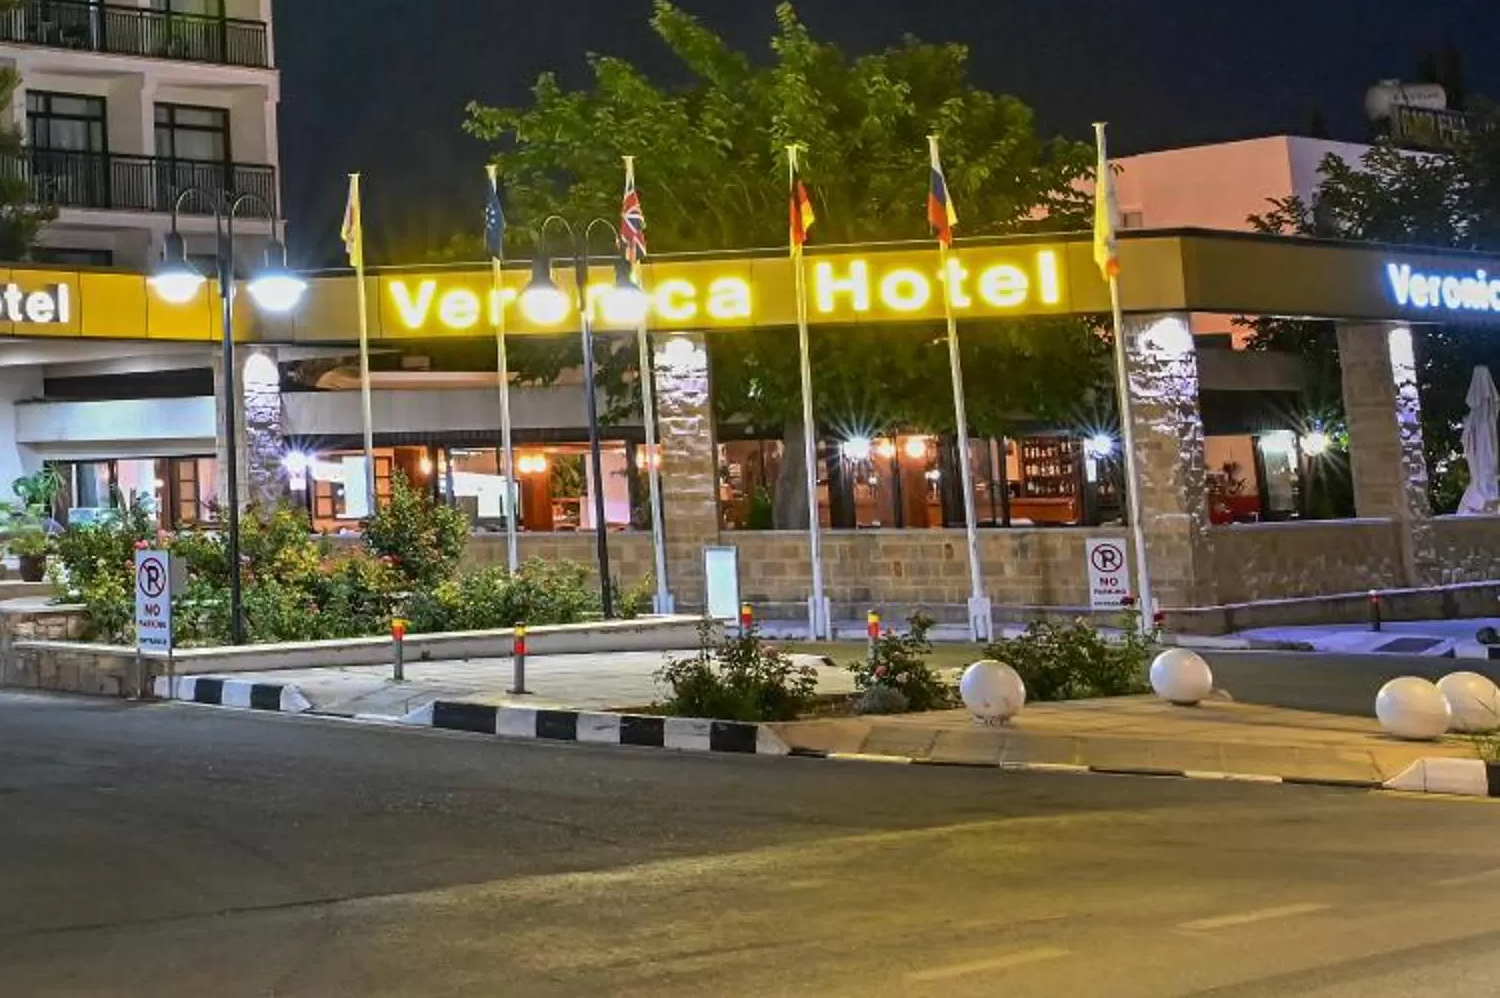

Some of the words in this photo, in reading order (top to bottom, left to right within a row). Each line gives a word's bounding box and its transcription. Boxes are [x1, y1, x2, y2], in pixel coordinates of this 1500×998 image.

[388, 275, 752, 329] Vernca
[815, 249, 1061, 313] Hotel
[1099, 577, 1119, 587] NO
[143, 603, 161, 617] NO
